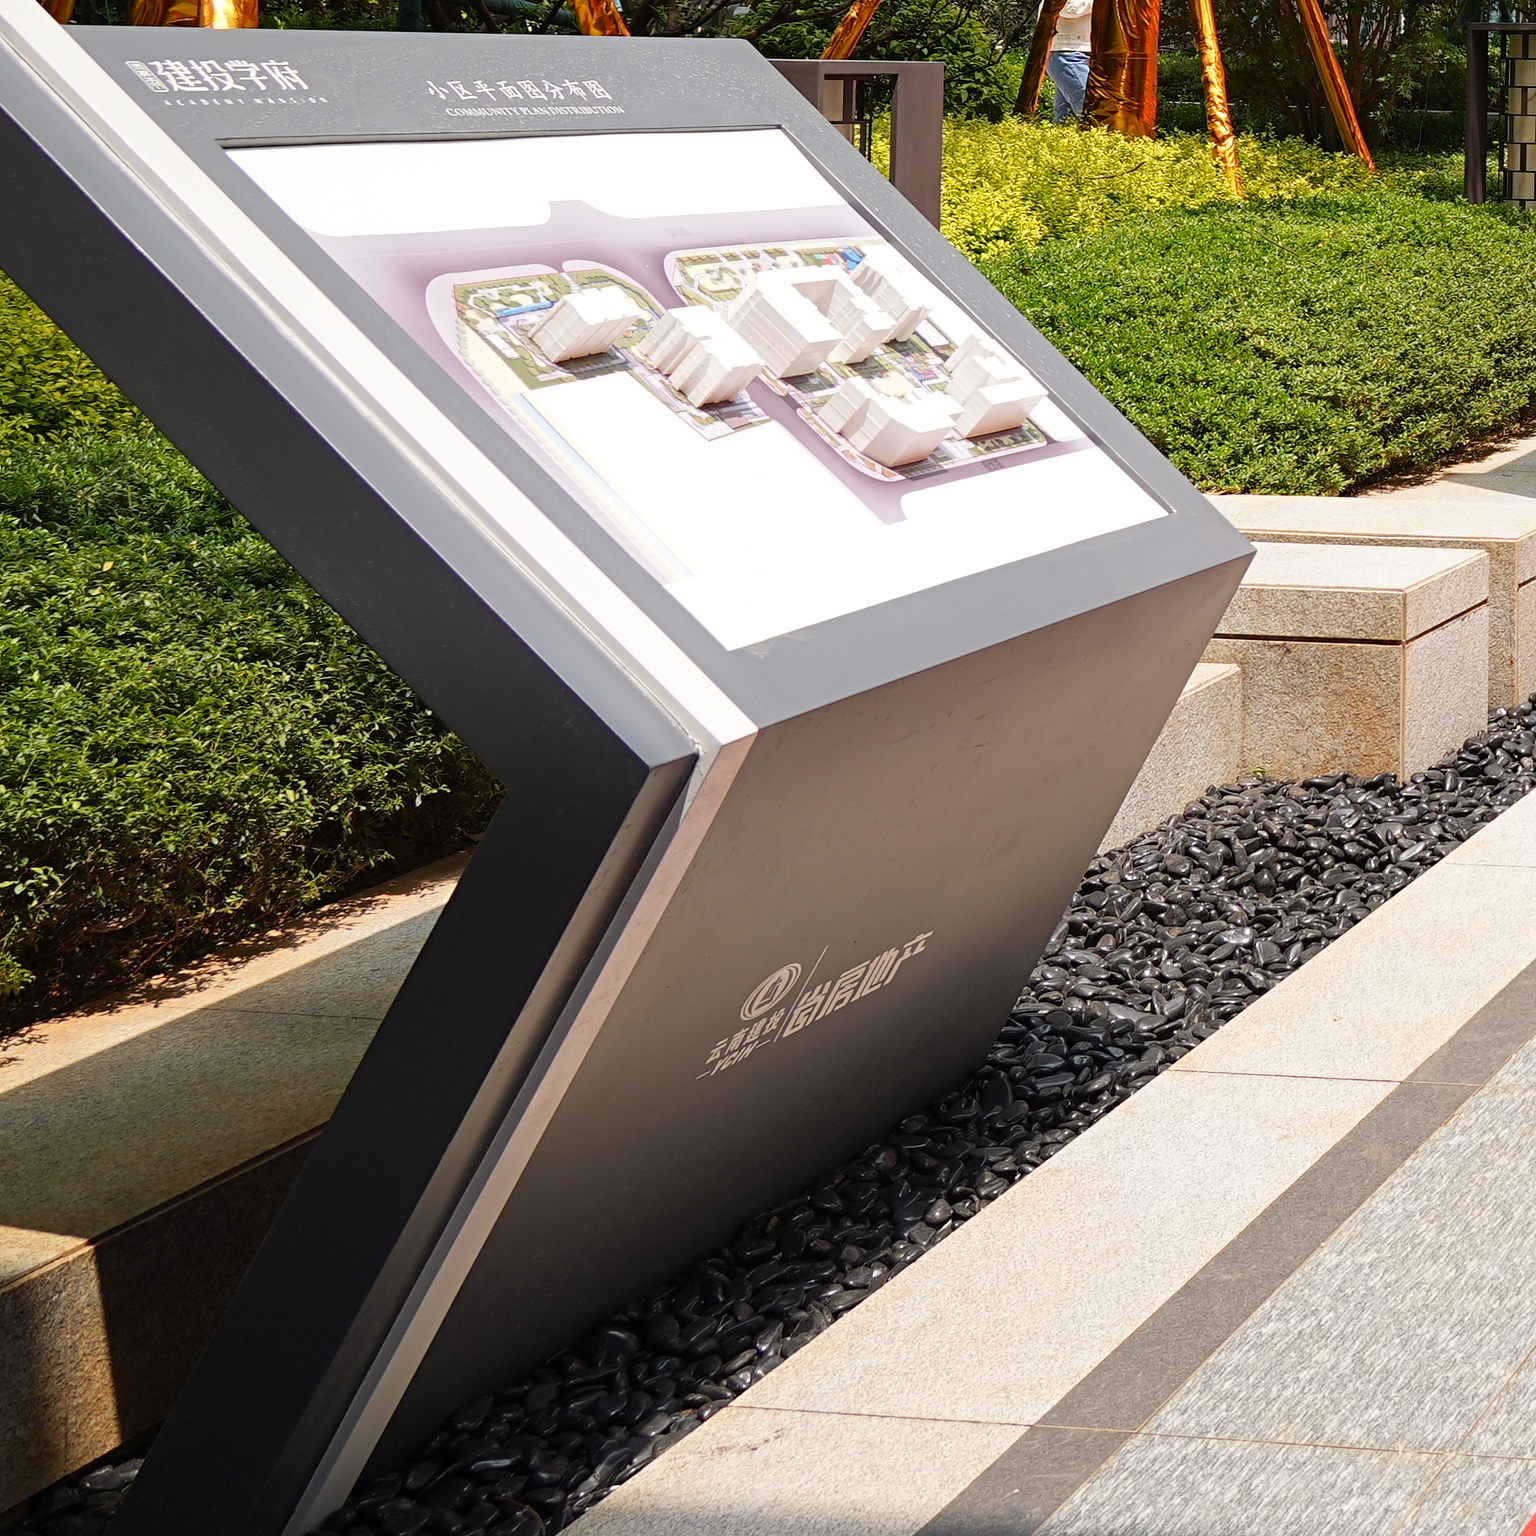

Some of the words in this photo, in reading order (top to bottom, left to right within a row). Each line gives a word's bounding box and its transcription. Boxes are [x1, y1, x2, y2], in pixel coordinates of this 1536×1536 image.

[148, 58, 309, 92] 建投学府
[426, 78, 613, 102] 小区平面图分布图
[445, 105, 519, 117] COMMUNITY
[521, 105, 551, 116] PLAN
[551, 105, 626, 115] DISTRIBUTION
[705, 1008, 786, 1065] 云南建投
[710, 1041, 758, 1076] YCIH
